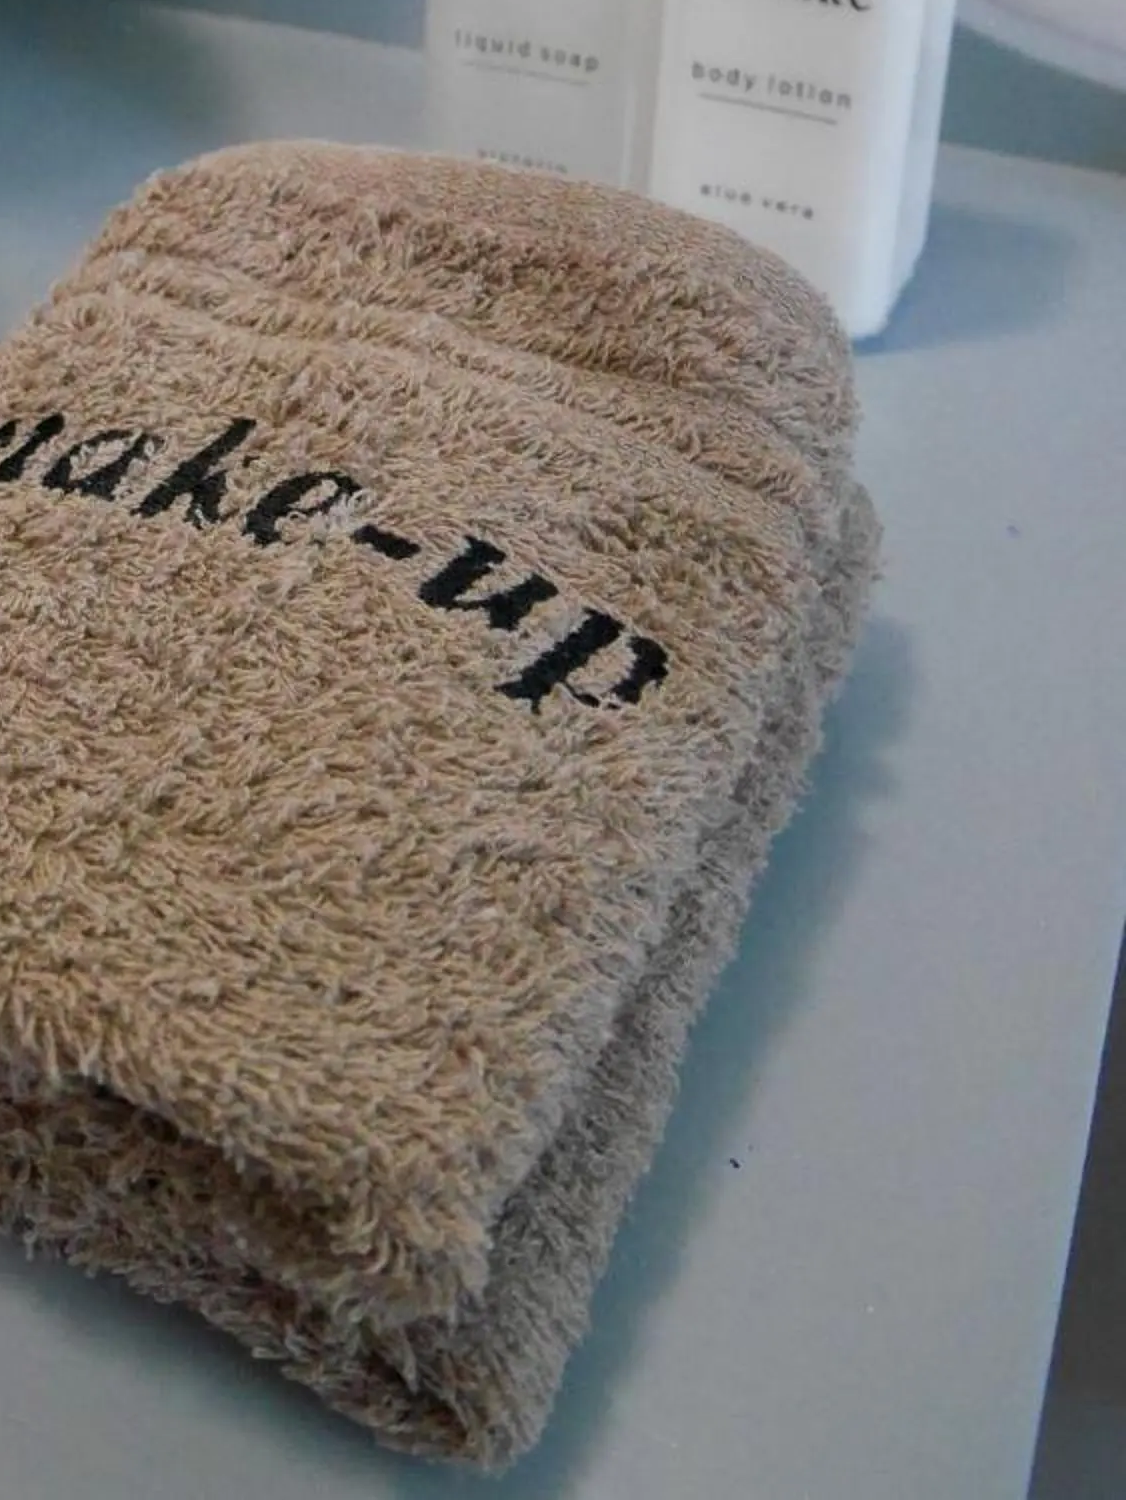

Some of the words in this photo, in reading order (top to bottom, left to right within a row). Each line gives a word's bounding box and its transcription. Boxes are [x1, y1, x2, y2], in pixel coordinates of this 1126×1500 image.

[454, 29, 532, 59] liquid
[540, 47, 600, 73] soap
[768, 73, 852, 110] lotion
